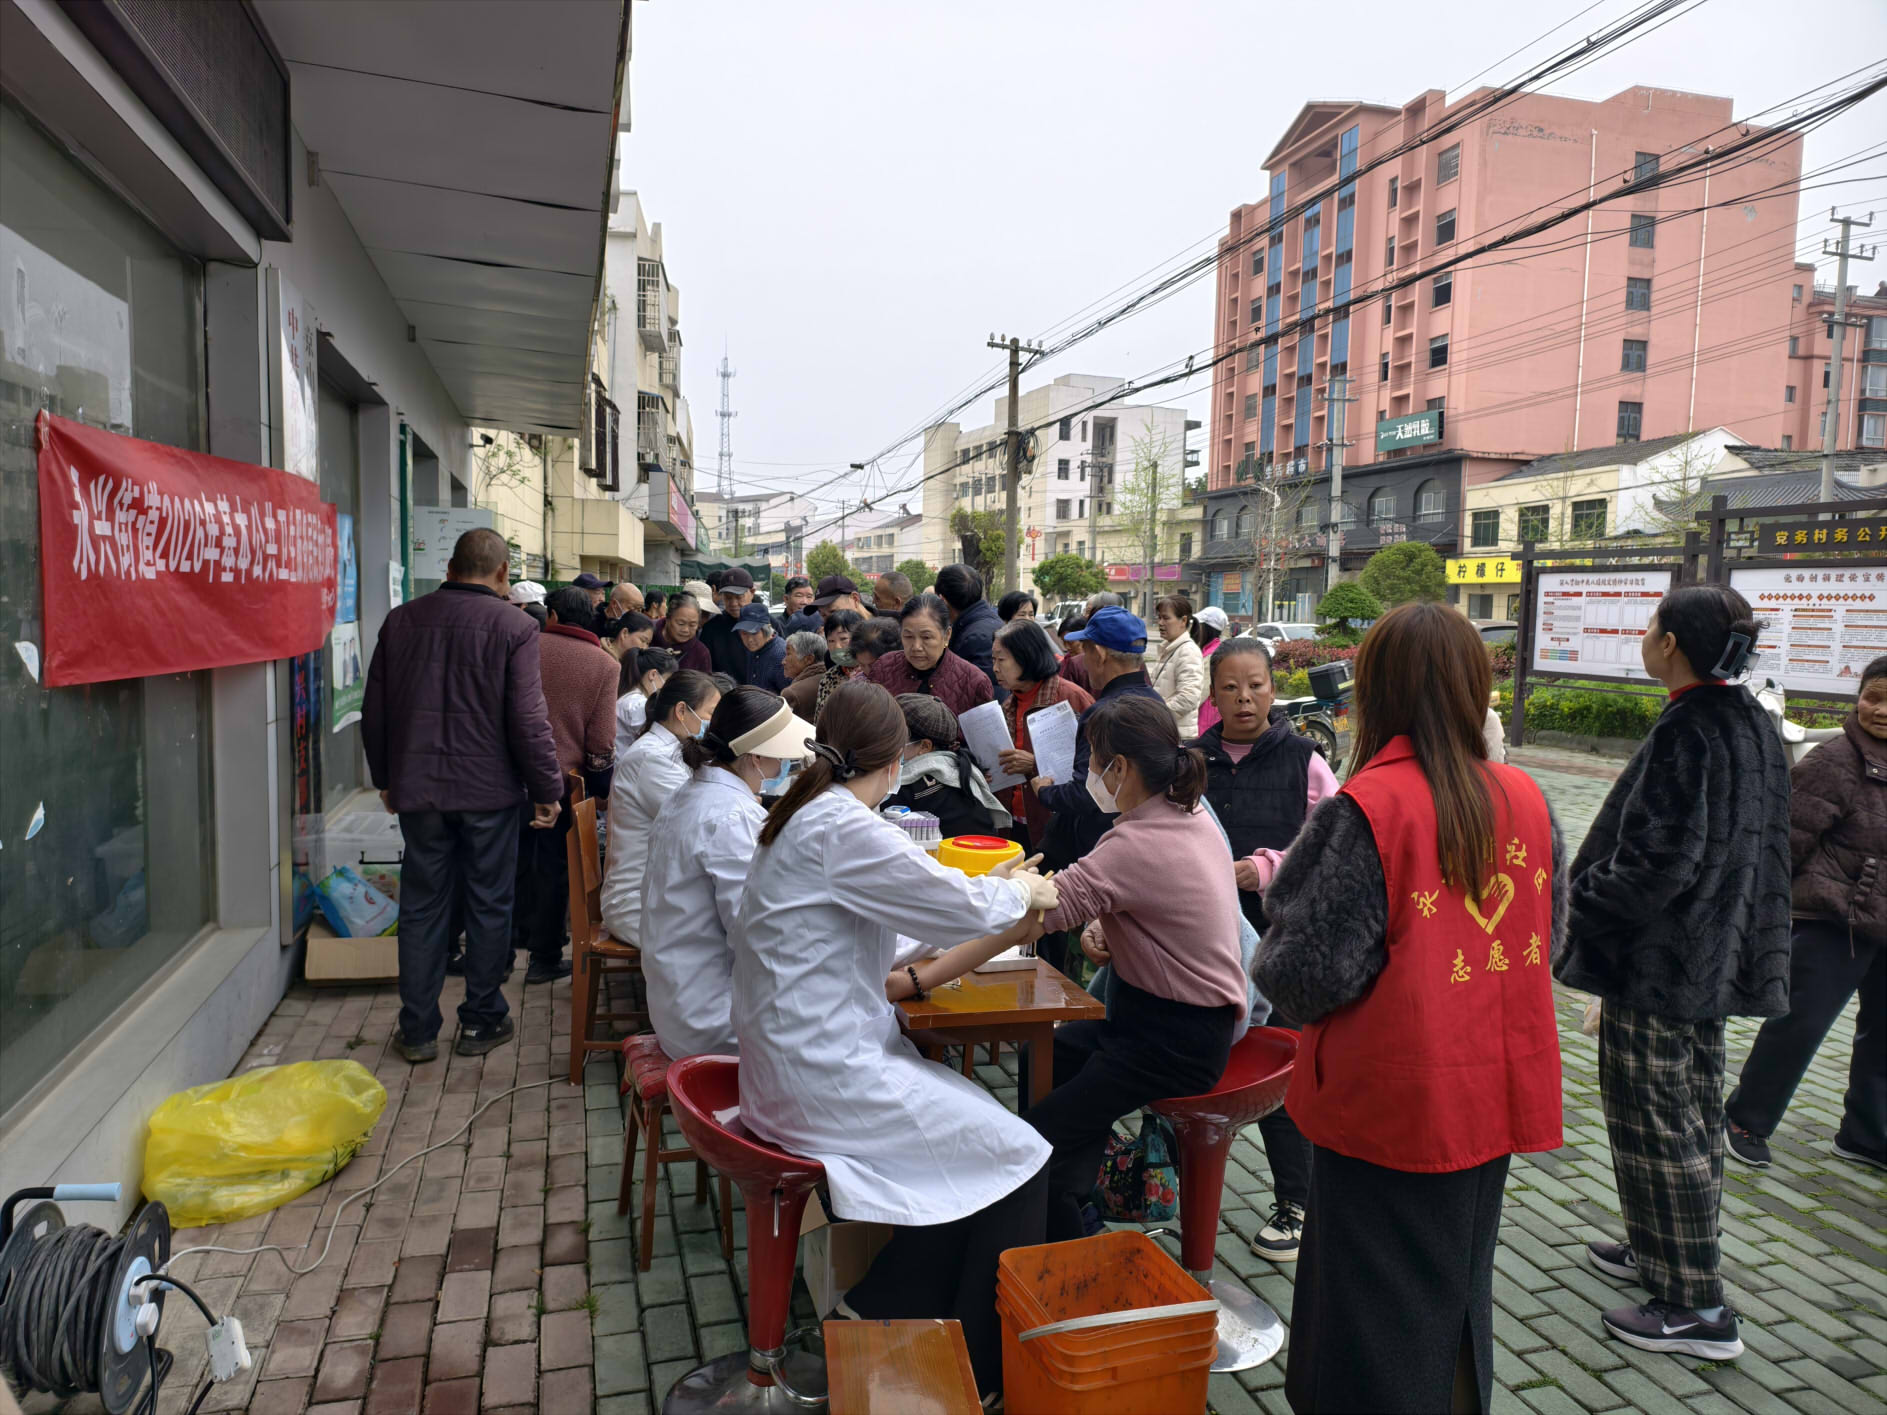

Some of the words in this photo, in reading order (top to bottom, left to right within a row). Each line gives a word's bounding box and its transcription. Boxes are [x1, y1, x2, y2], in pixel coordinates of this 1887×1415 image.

[1457, 561, 1506, 580] 柠檬仔
[1450, 932, 1542, 984] 志愿者
